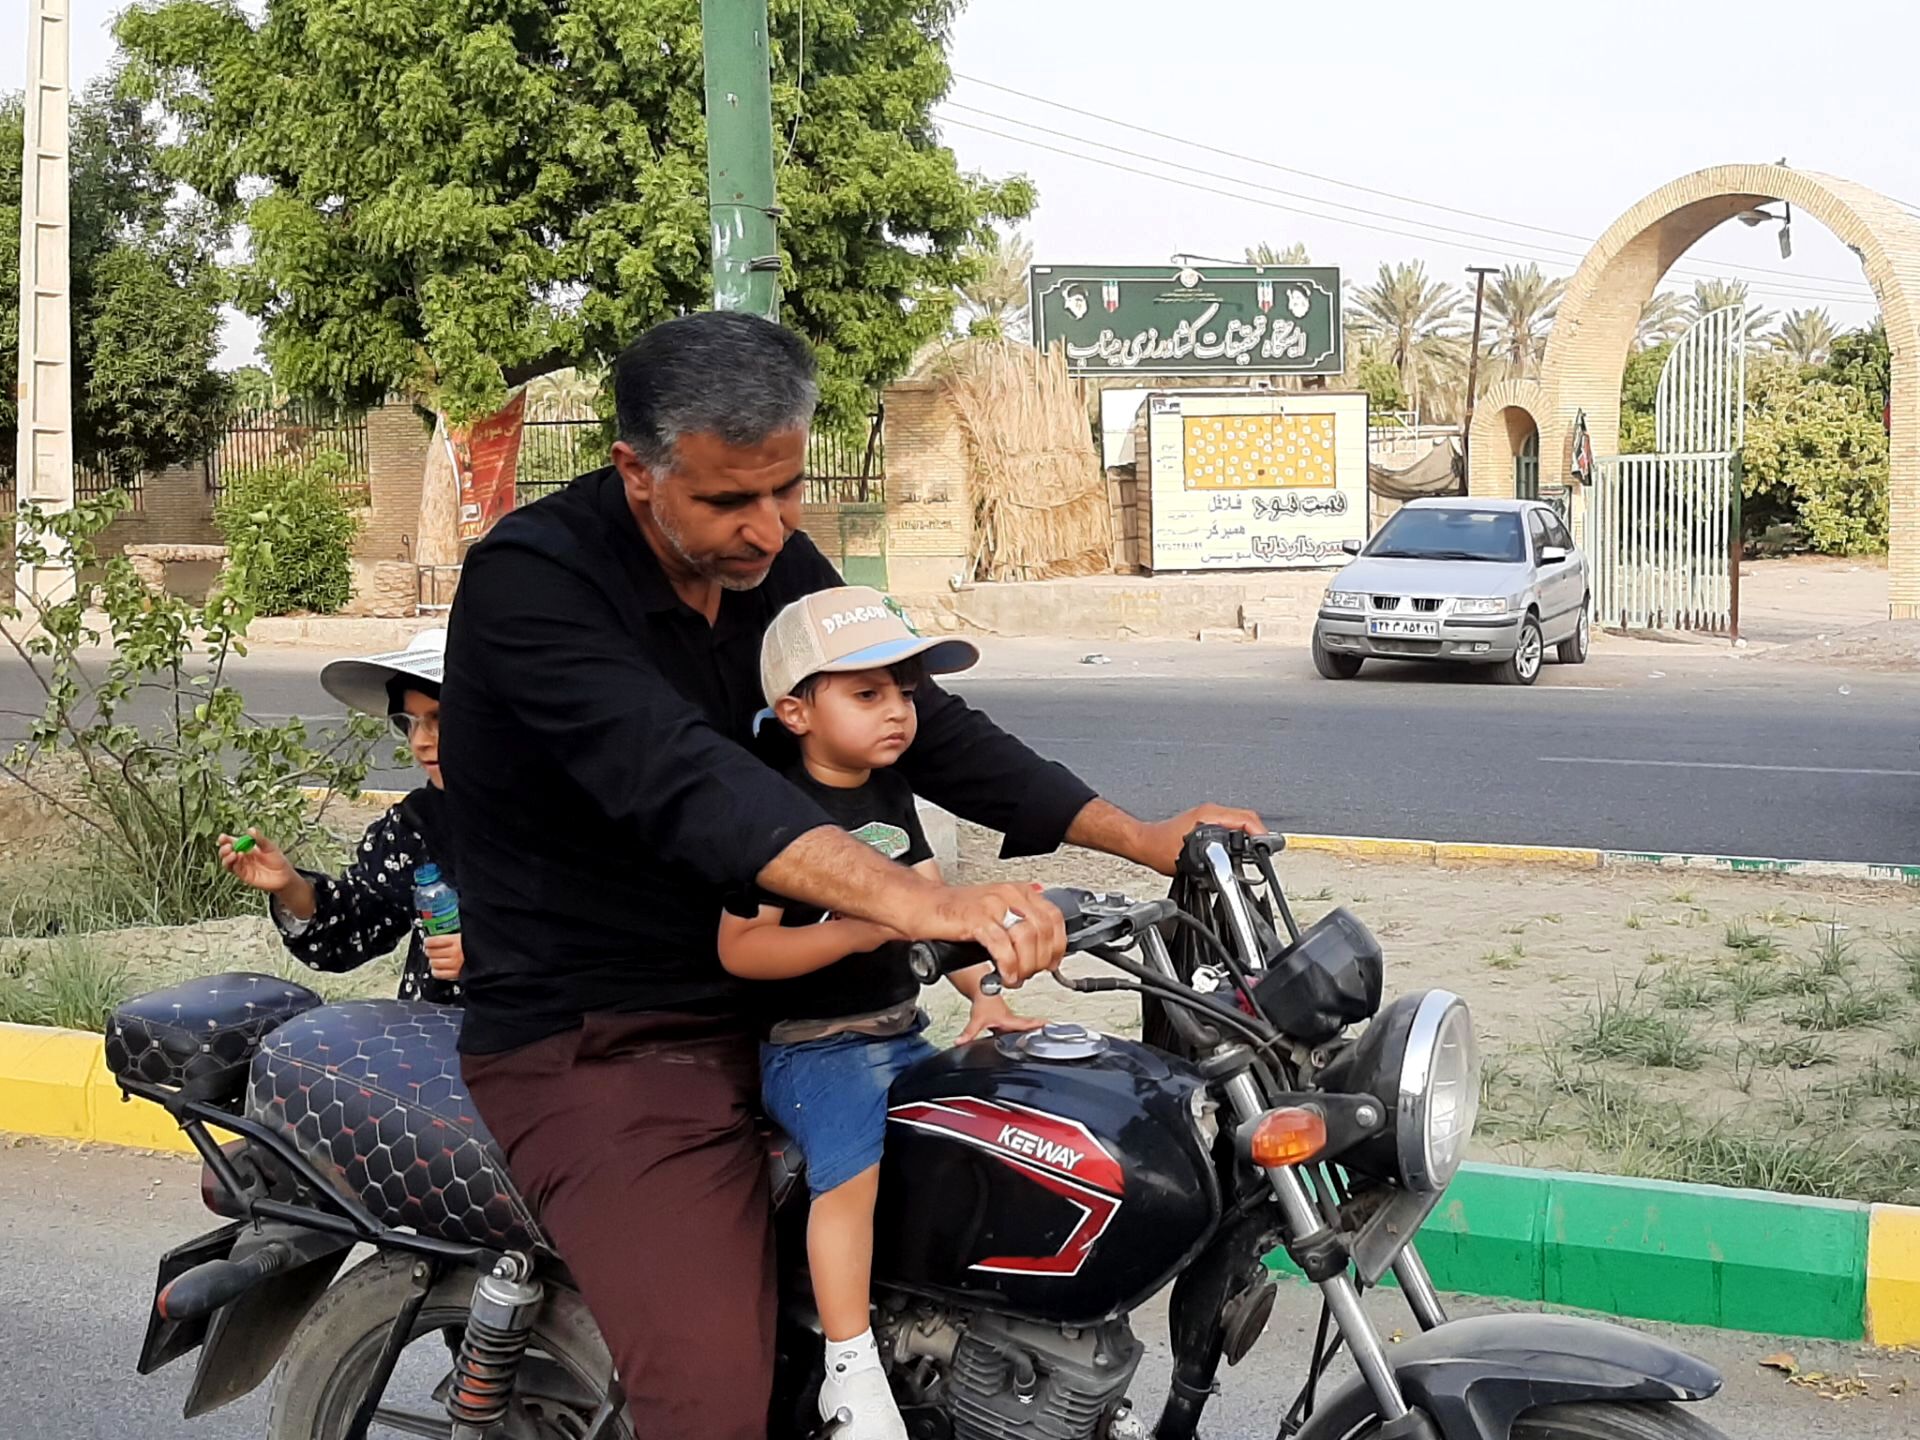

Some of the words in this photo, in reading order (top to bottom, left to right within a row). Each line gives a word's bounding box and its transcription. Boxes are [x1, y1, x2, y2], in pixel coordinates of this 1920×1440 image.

[1066, 329, 1122, 367] میناب
[1121, 302, 1220, 366] کشاورزی
[1208, 494, 1242, 512] فلافل
[1252, 492, 1299, 521] فود
[821, 605, 888, 635] DRAGON
[997, 1123, 1085, 1170] KEEWAY
